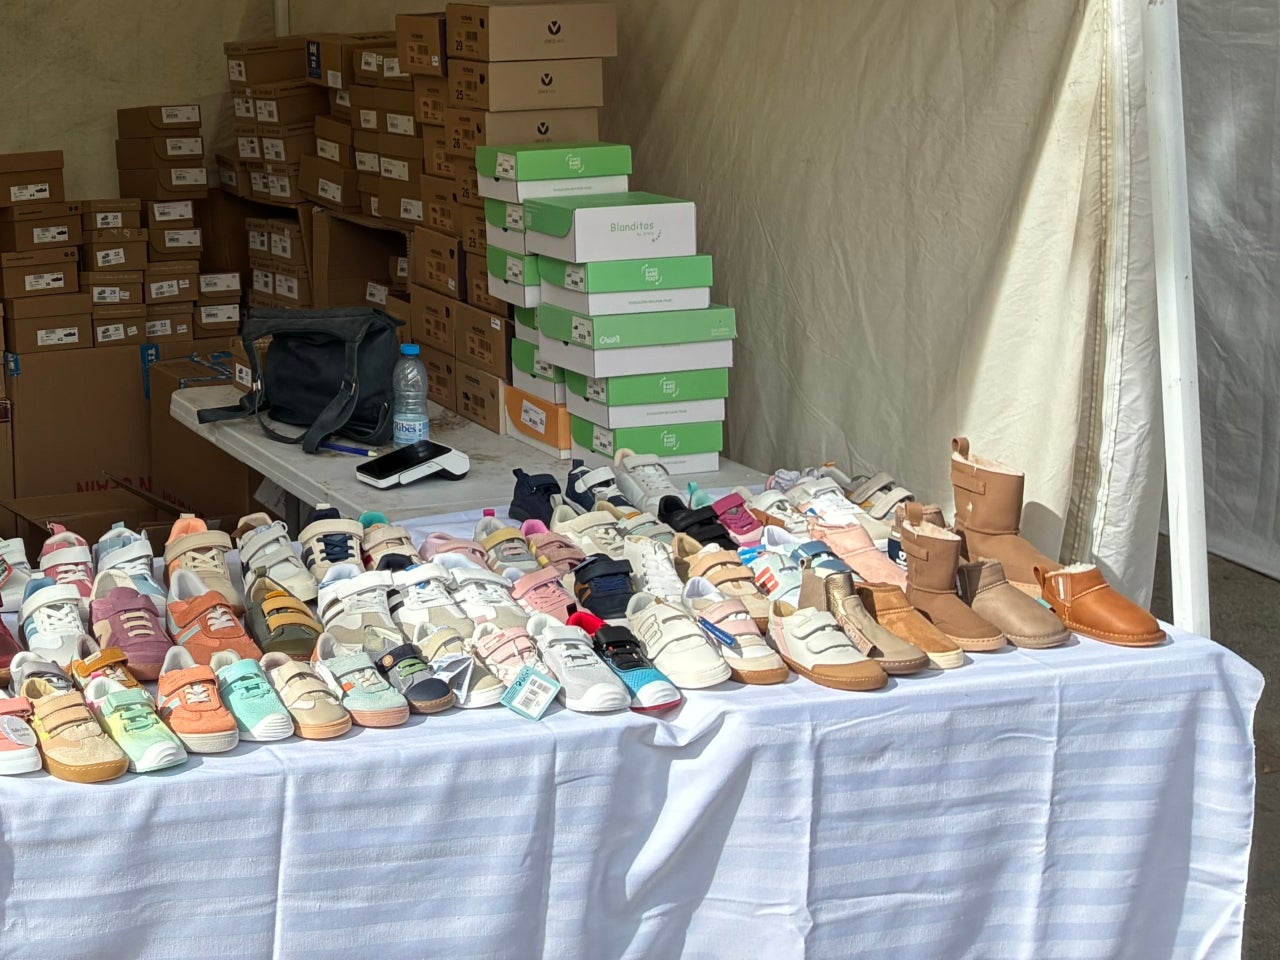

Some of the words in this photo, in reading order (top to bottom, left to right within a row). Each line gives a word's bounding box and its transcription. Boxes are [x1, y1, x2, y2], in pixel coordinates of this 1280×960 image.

[456, 89, 464, 100] 25
[610, 220, 654, 232] Blanditos
[394, 420, 416, 433] Ribes
